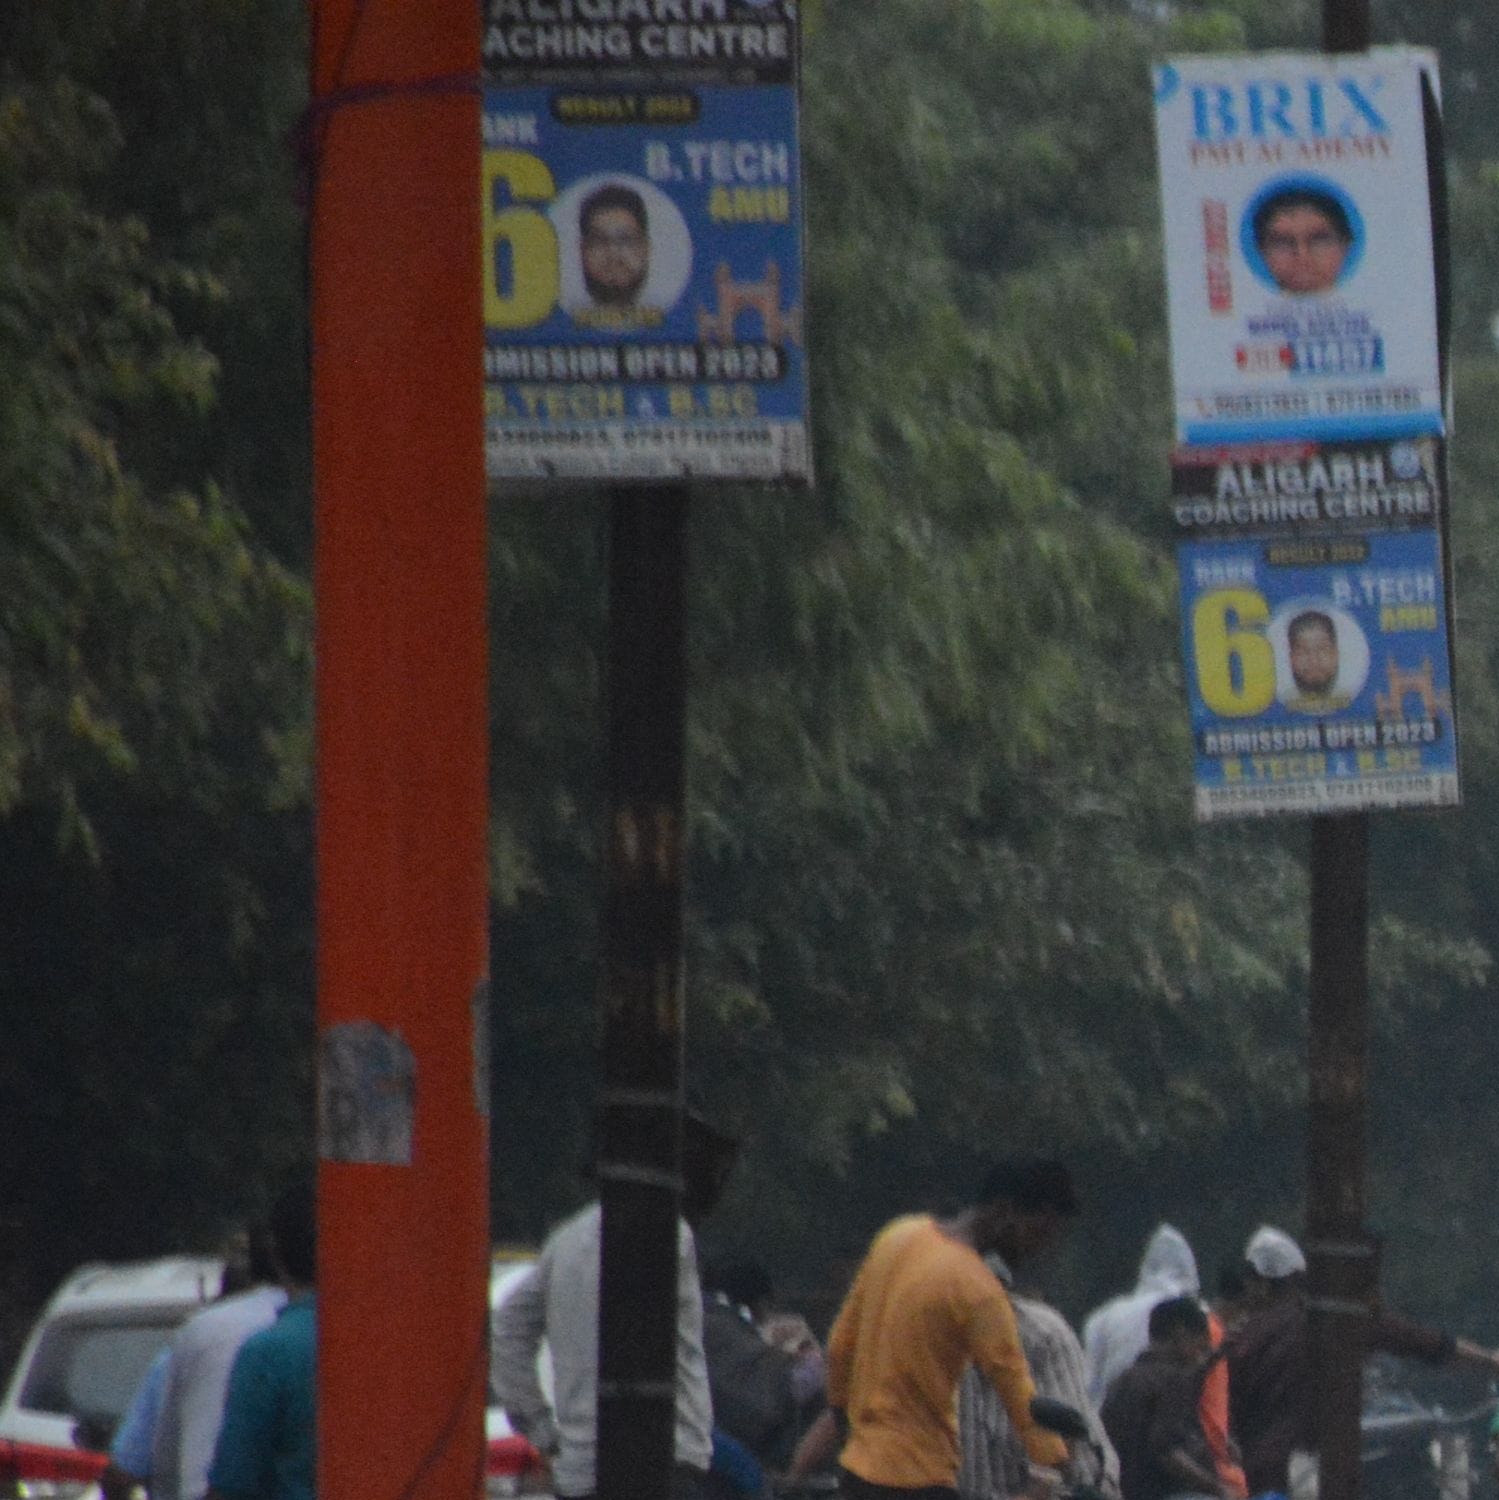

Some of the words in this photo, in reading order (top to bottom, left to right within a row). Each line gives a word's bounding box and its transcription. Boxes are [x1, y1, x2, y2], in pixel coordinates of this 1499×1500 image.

[640, 23, 788, 58] CENTRE
[1189, 74, 1393, 142] BRIX
[644, 138, 790, 183] B.TECH
[1259, 133, 1393, 164] ACADEMY
[1217, 453, 1386, 499] ALIGARH
[1175, 496, 1320, 525] COACHING
[1324, 485, 1432, 519] CENTRE
[1331, 569, 1436, 606] B.TECH
[1193, 588, 1275, 718] 6
[1205, 726, 1321, 756] ADMISSION
[1325, 724, 1377, 748] OPEN
